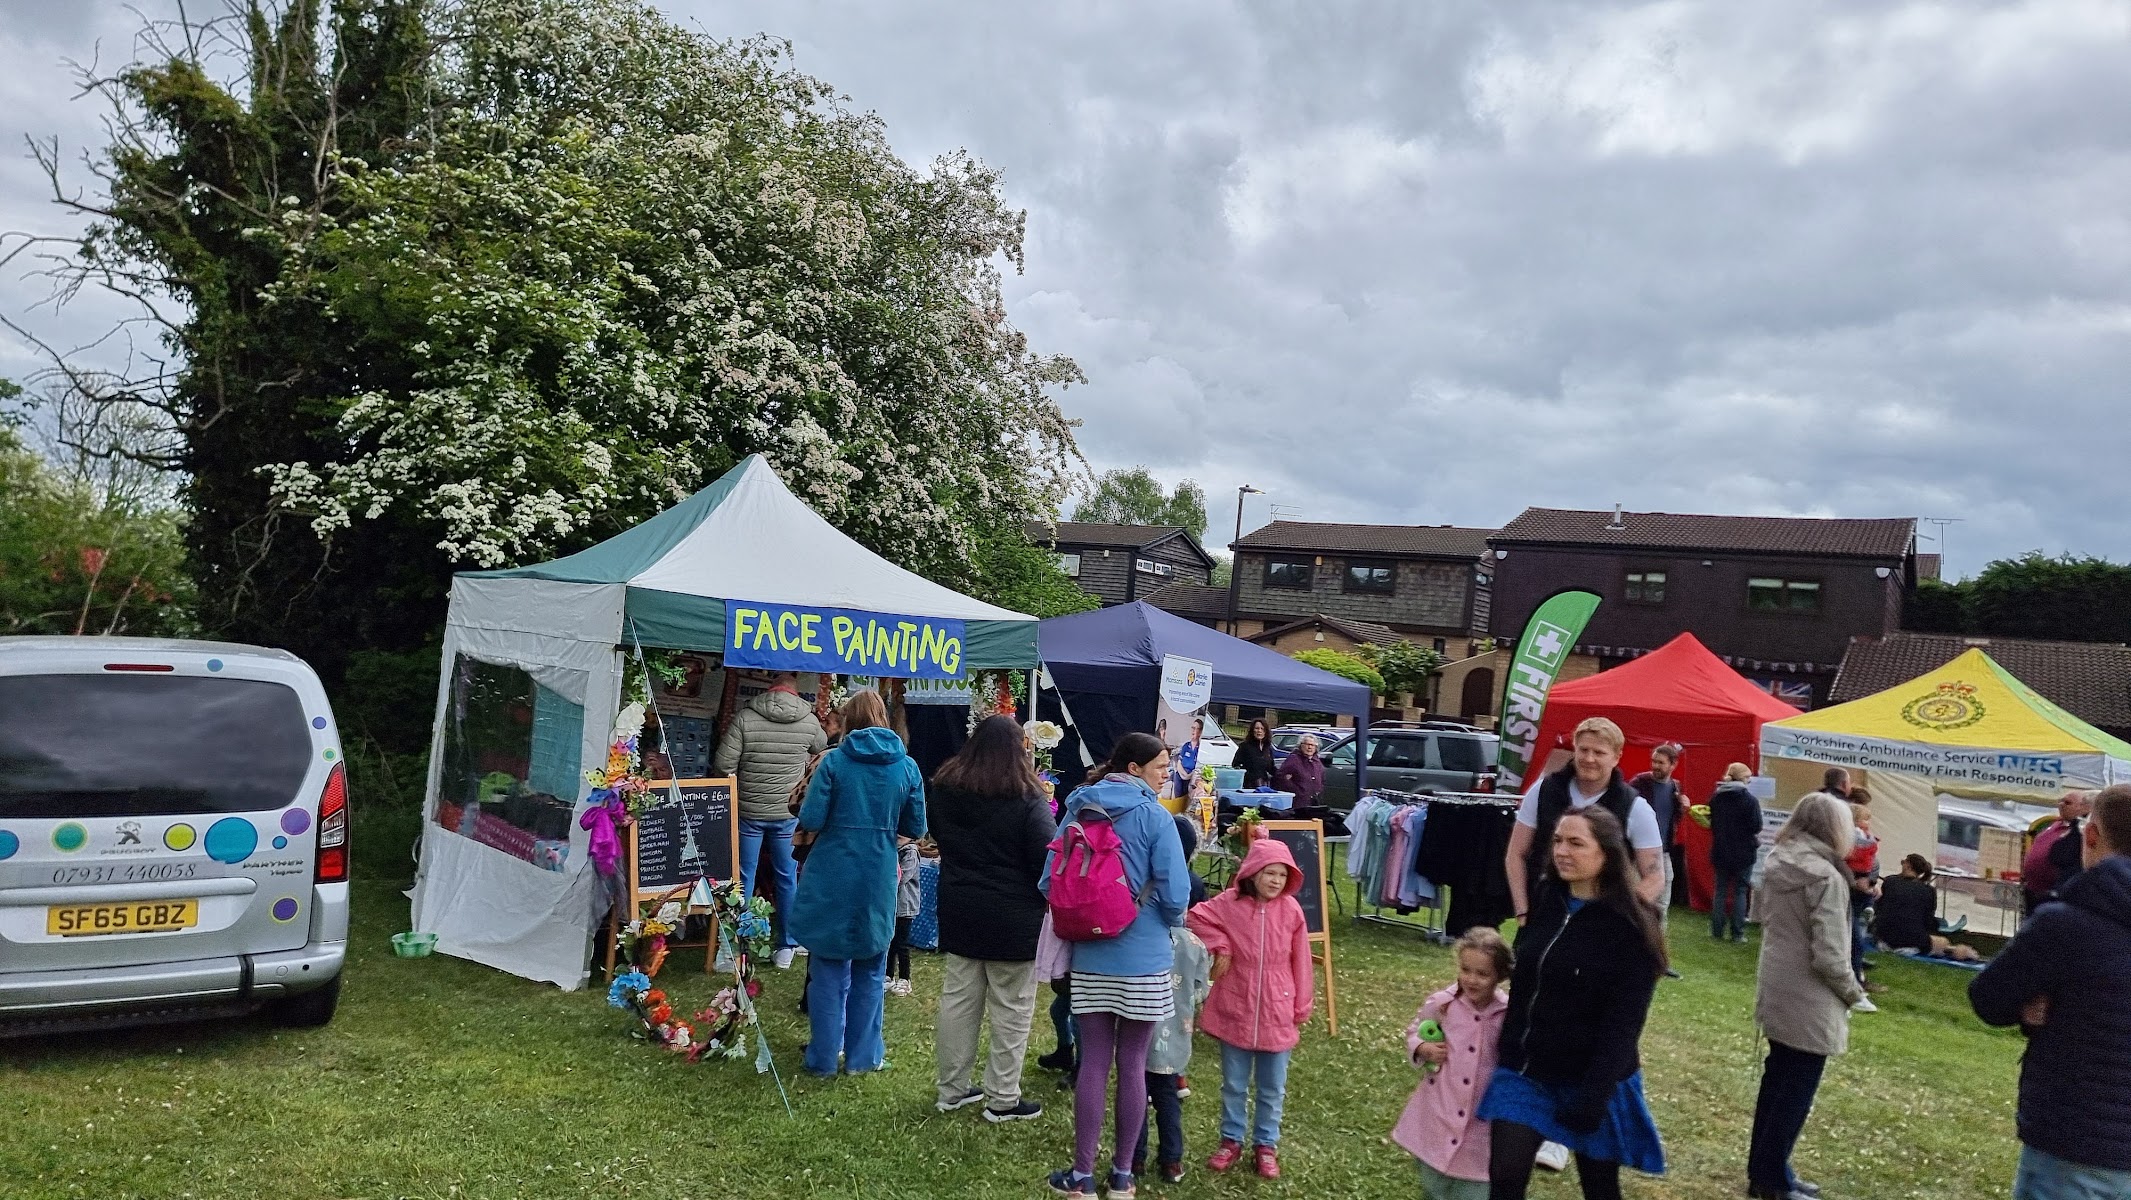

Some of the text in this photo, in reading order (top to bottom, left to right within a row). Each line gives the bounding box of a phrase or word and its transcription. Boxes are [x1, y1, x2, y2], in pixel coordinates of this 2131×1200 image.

[733, 608, 961, 675] FACE PAINTING
[1502, 662, 1552, 763] FIRST
[1794, 734, 2061, 774] Yorkshire Ambulance Service NHS
[1804, 749, 2056, 789] Rothwell Community First Responders
[639, 819, 665, 827] FLOWERS
[639, 827, 664, 836] FOOTBALL
[640, 833, 667, 843] BUTTERFLY
[639, 841, 669, 851] SPIDERMAN
[53, 863, 196, 883] 07931 440058
[640, 865, 666, 873] PRINCESS
[640, 874, 663, 882] DRAGON
[58, 903, 187, 930] SF65 GBZ
